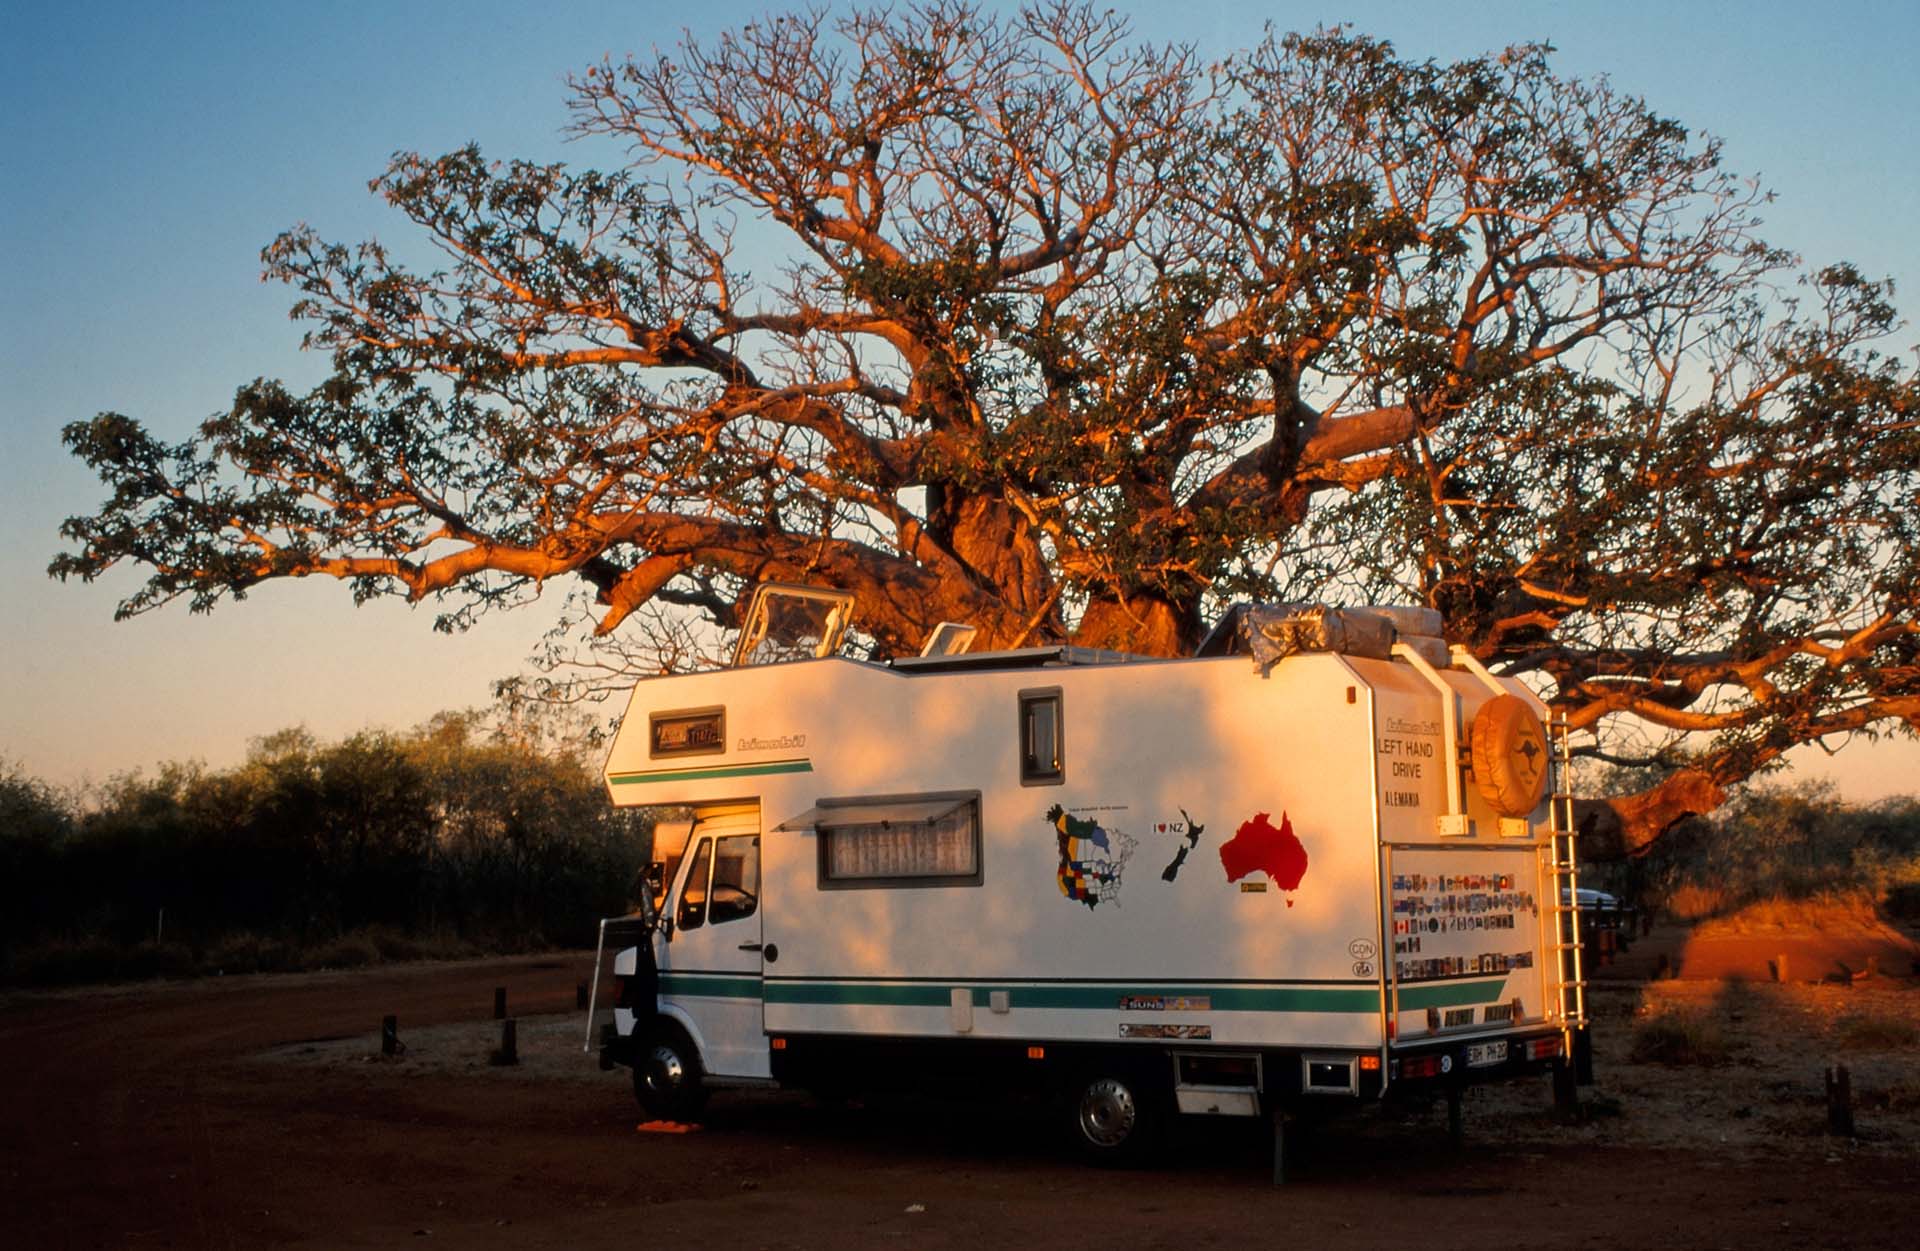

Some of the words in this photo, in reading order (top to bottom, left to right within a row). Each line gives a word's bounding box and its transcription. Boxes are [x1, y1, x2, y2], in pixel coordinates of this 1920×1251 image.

[1378, 739, 1403, 756] LEFT
[1406, 741, 1433, 758] HAND
[1392, 761, 1422, 779] DRIVE
[1169, 823, 1183, 833] NZ
[1352, 944, 1373, 954] CDN
